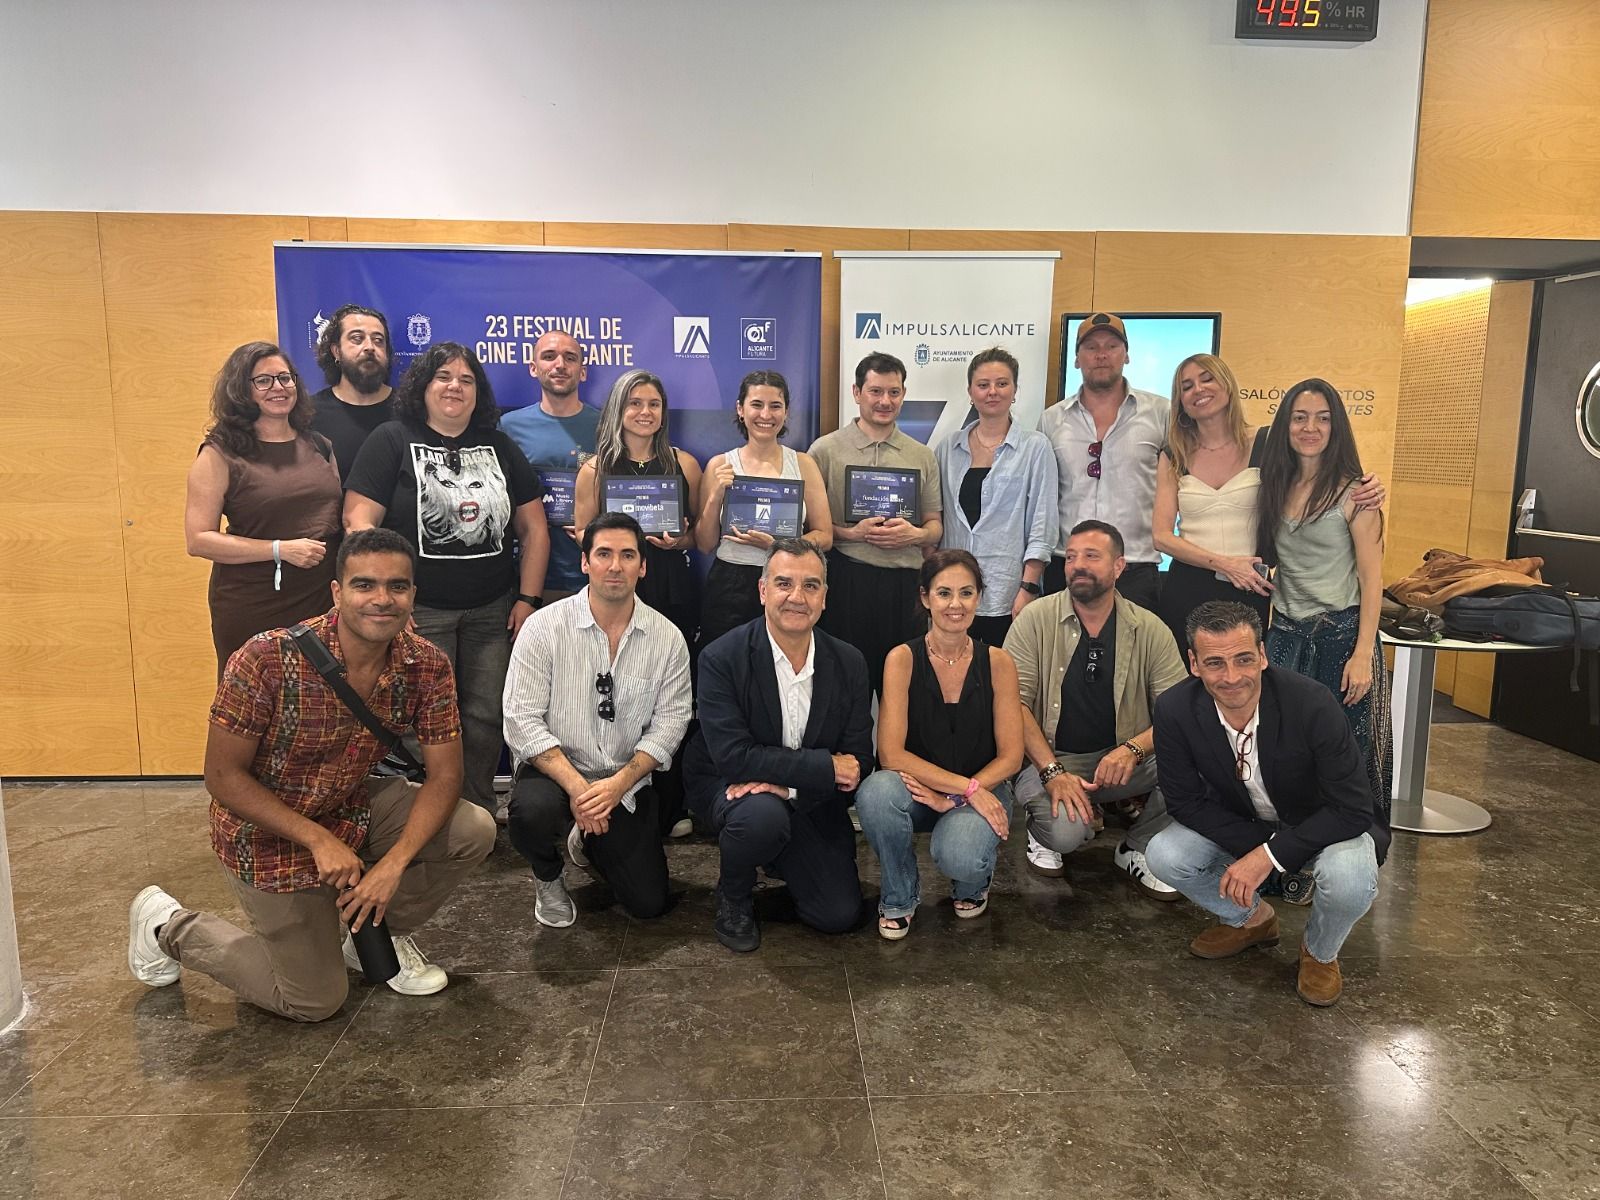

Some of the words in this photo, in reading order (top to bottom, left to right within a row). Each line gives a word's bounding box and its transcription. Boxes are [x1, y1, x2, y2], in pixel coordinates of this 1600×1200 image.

[1345, 6, 1365, 18] HR
[485, 315, 508, 337] 23
[513, 316, 595, 340] FESTIVAL
[600, 317, 622, 340] DE
[885, 323, 1035, 336] IMPULSALICANTE
[475, 341, 517, 364] CINE
[418, 448, 446, 465] LAD
